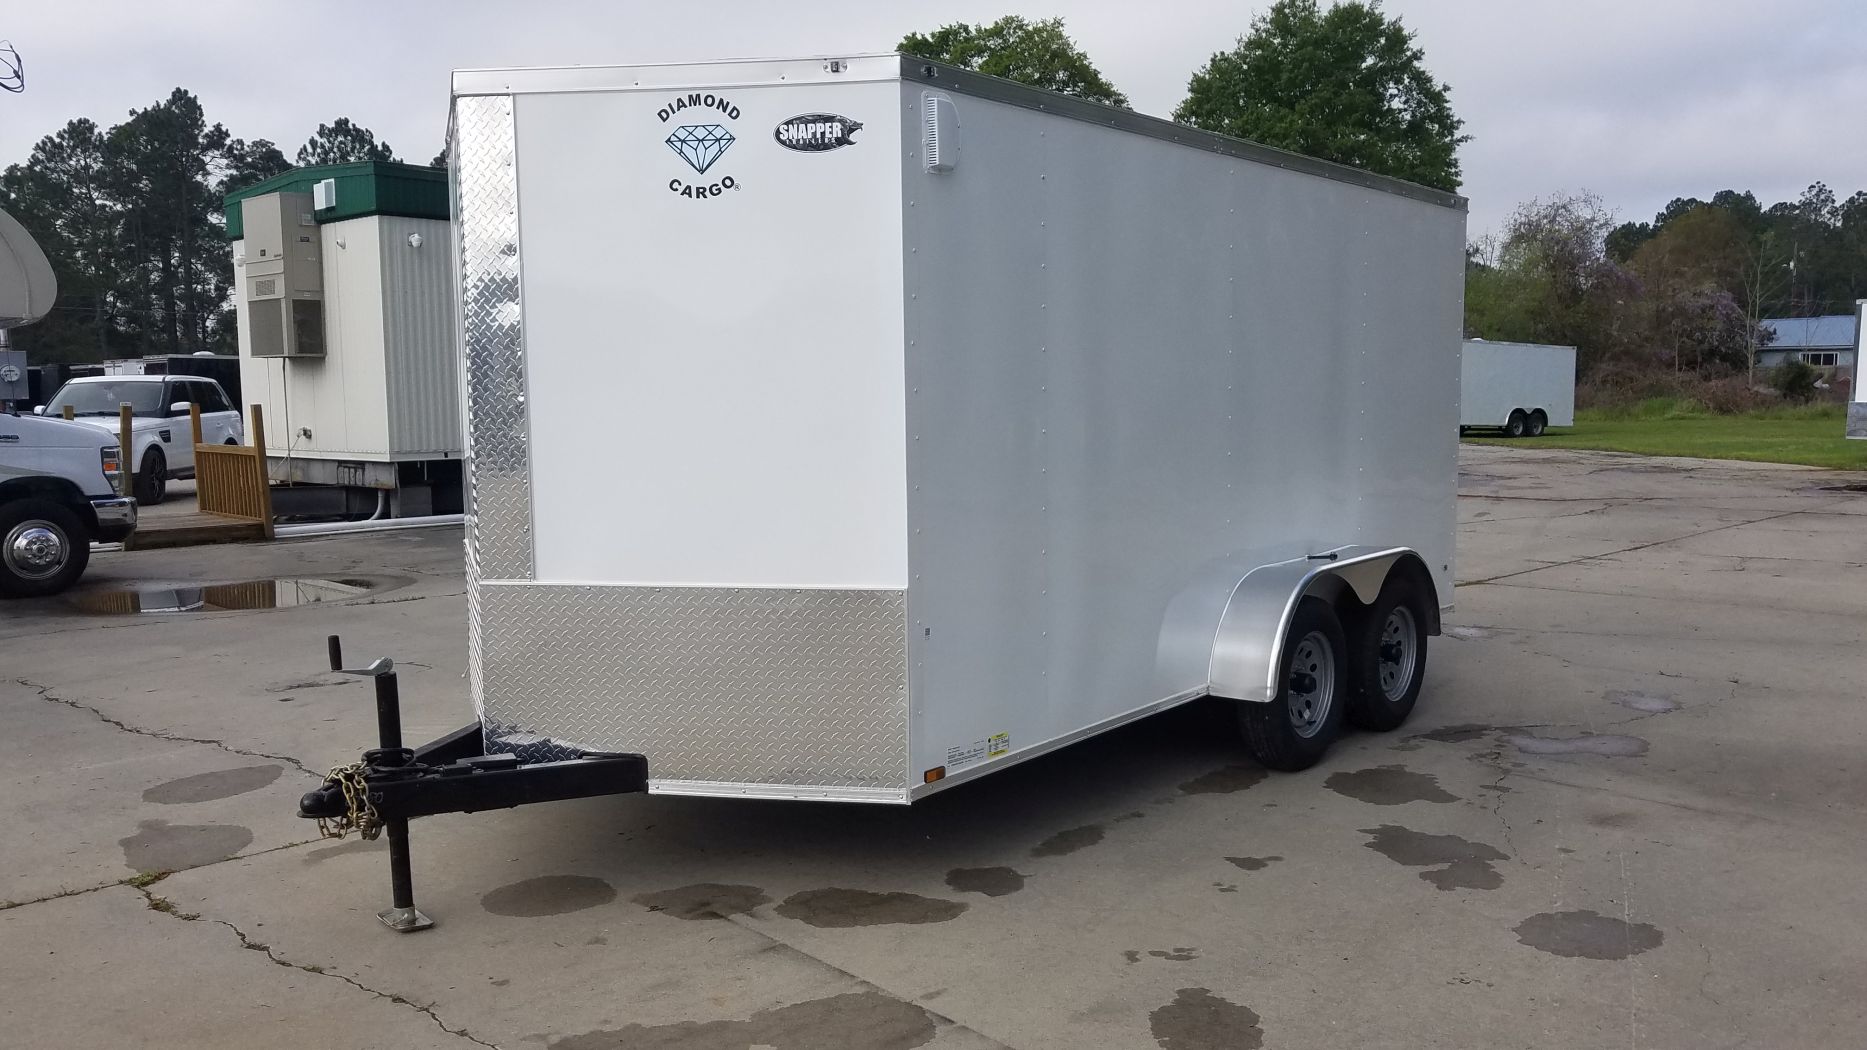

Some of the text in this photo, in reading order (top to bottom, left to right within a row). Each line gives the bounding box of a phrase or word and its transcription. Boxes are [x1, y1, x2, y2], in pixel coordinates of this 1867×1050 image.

[657, 93, 741, 123] DIAMOND
[778, 122, 842, 140] SNAPPER
[668, 175, 735, 199] CARGO
